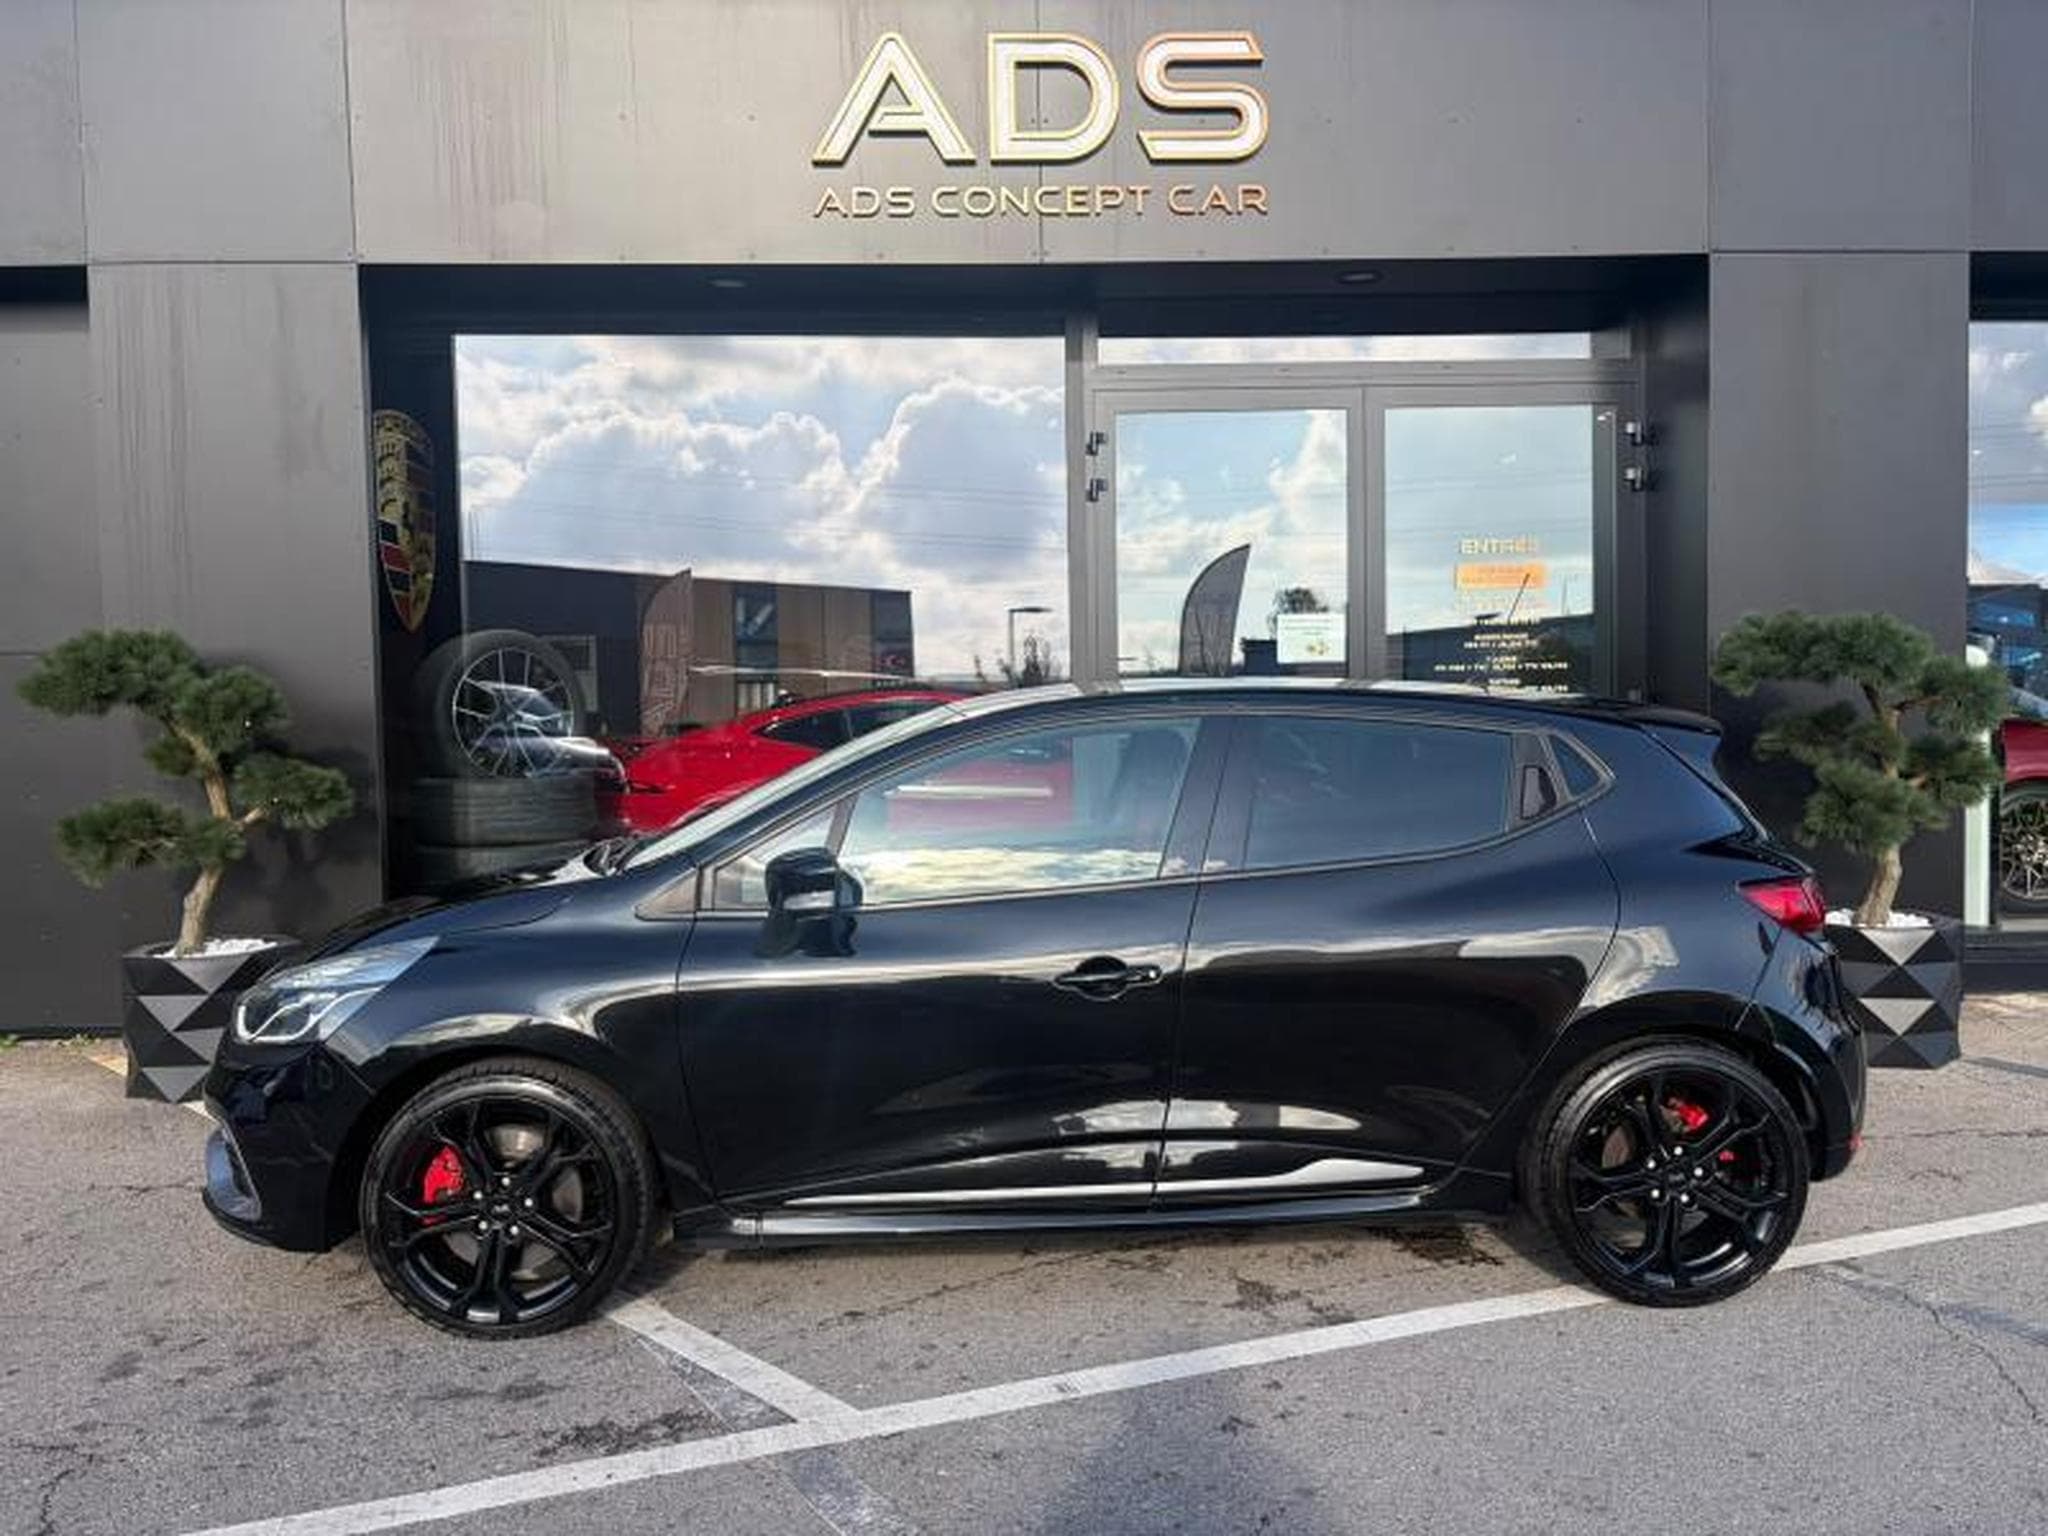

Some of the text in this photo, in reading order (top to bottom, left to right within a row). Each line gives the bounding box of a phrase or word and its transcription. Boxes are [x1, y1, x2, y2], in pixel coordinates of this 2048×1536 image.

[812, 31, 1268, 165] ADS
[814, 184, 1269, 218] ADS CONCEPT CAR
